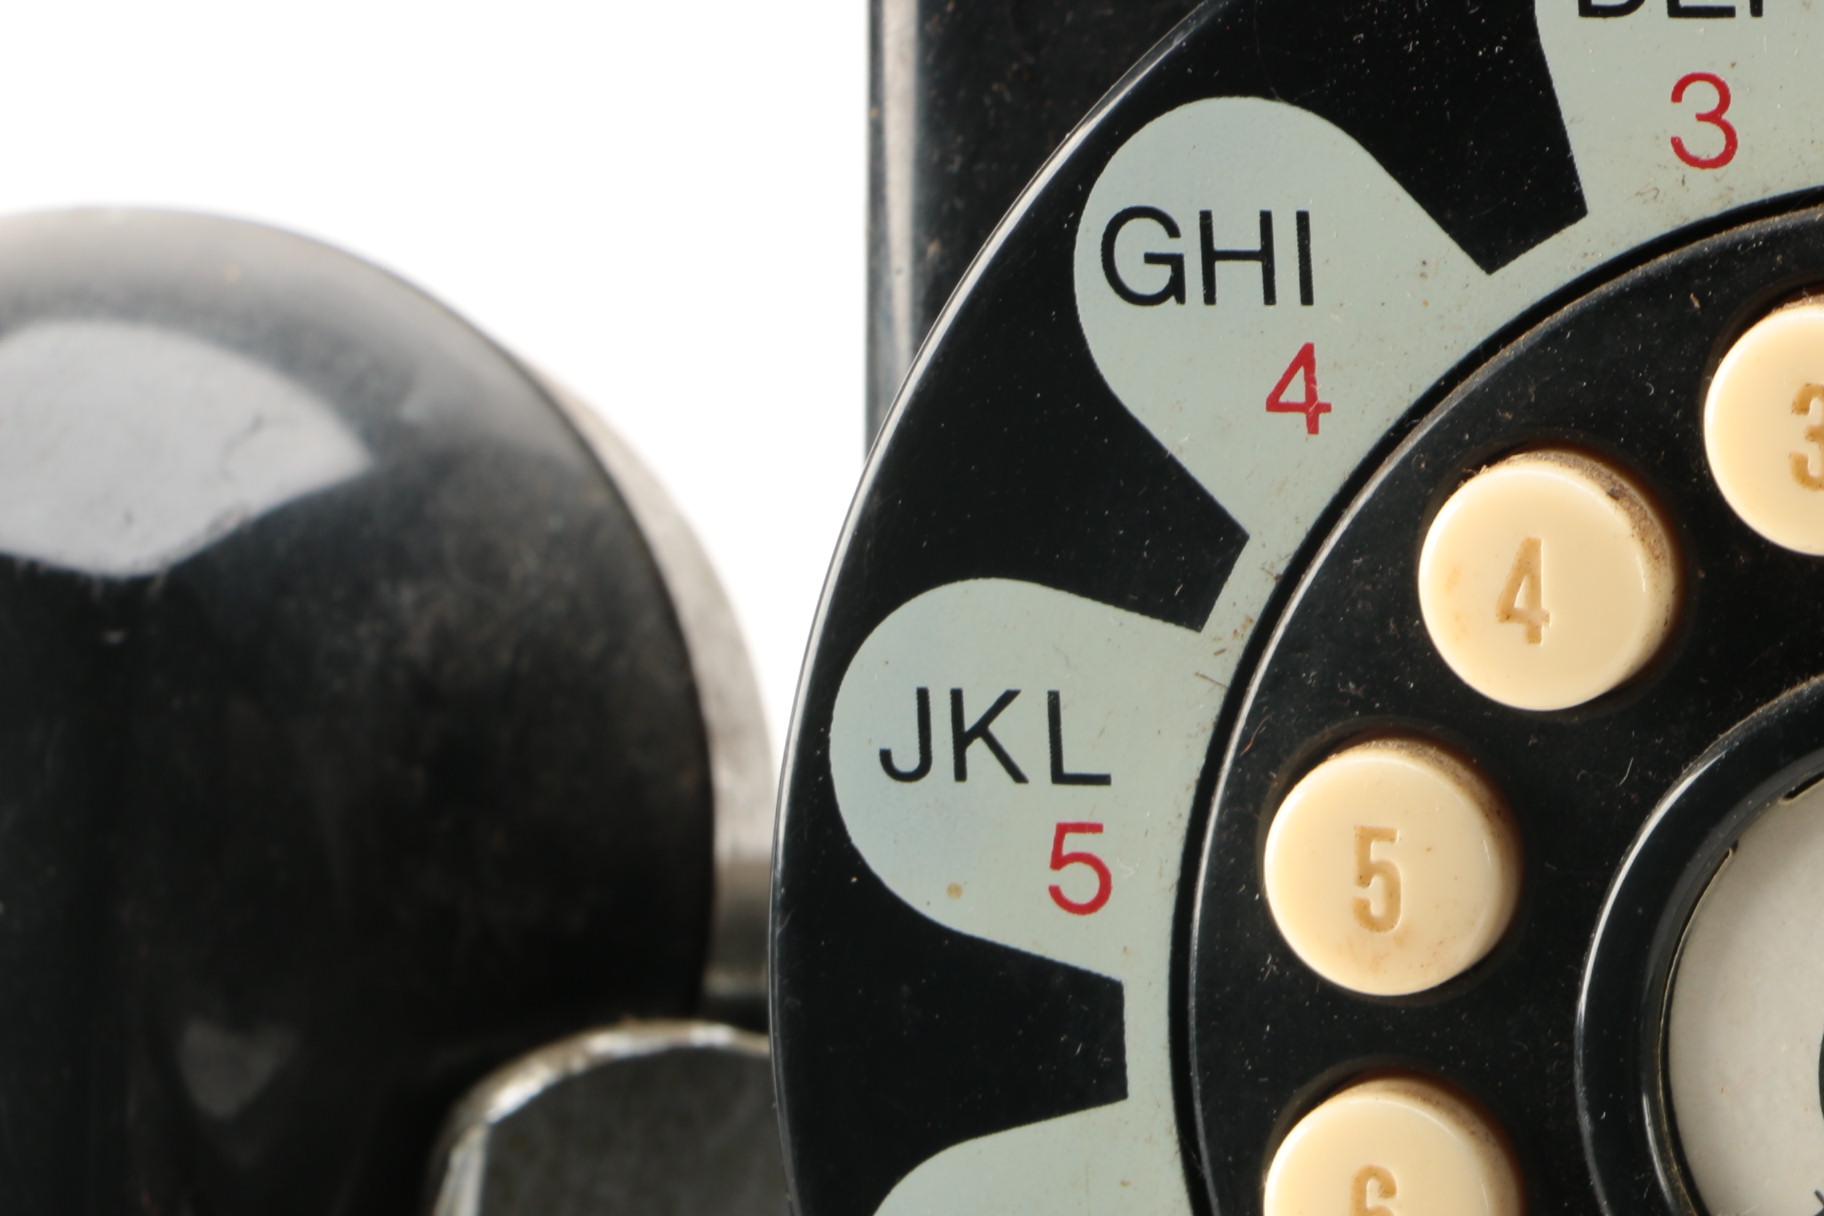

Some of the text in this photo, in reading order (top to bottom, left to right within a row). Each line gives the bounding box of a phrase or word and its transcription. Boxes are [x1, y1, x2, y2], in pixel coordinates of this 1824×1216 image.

[1672, 73, 1737, 169] 3
[1101, 206, 1313, 306] GHI
[1267, 343, 1331, 435] 4
[1496, 538, 1541, 644] 4
[879, 688, 1111, 785] JKL
[1050, 823, 1112, 915] 5
[1354, 826, 1400, 932] 5
